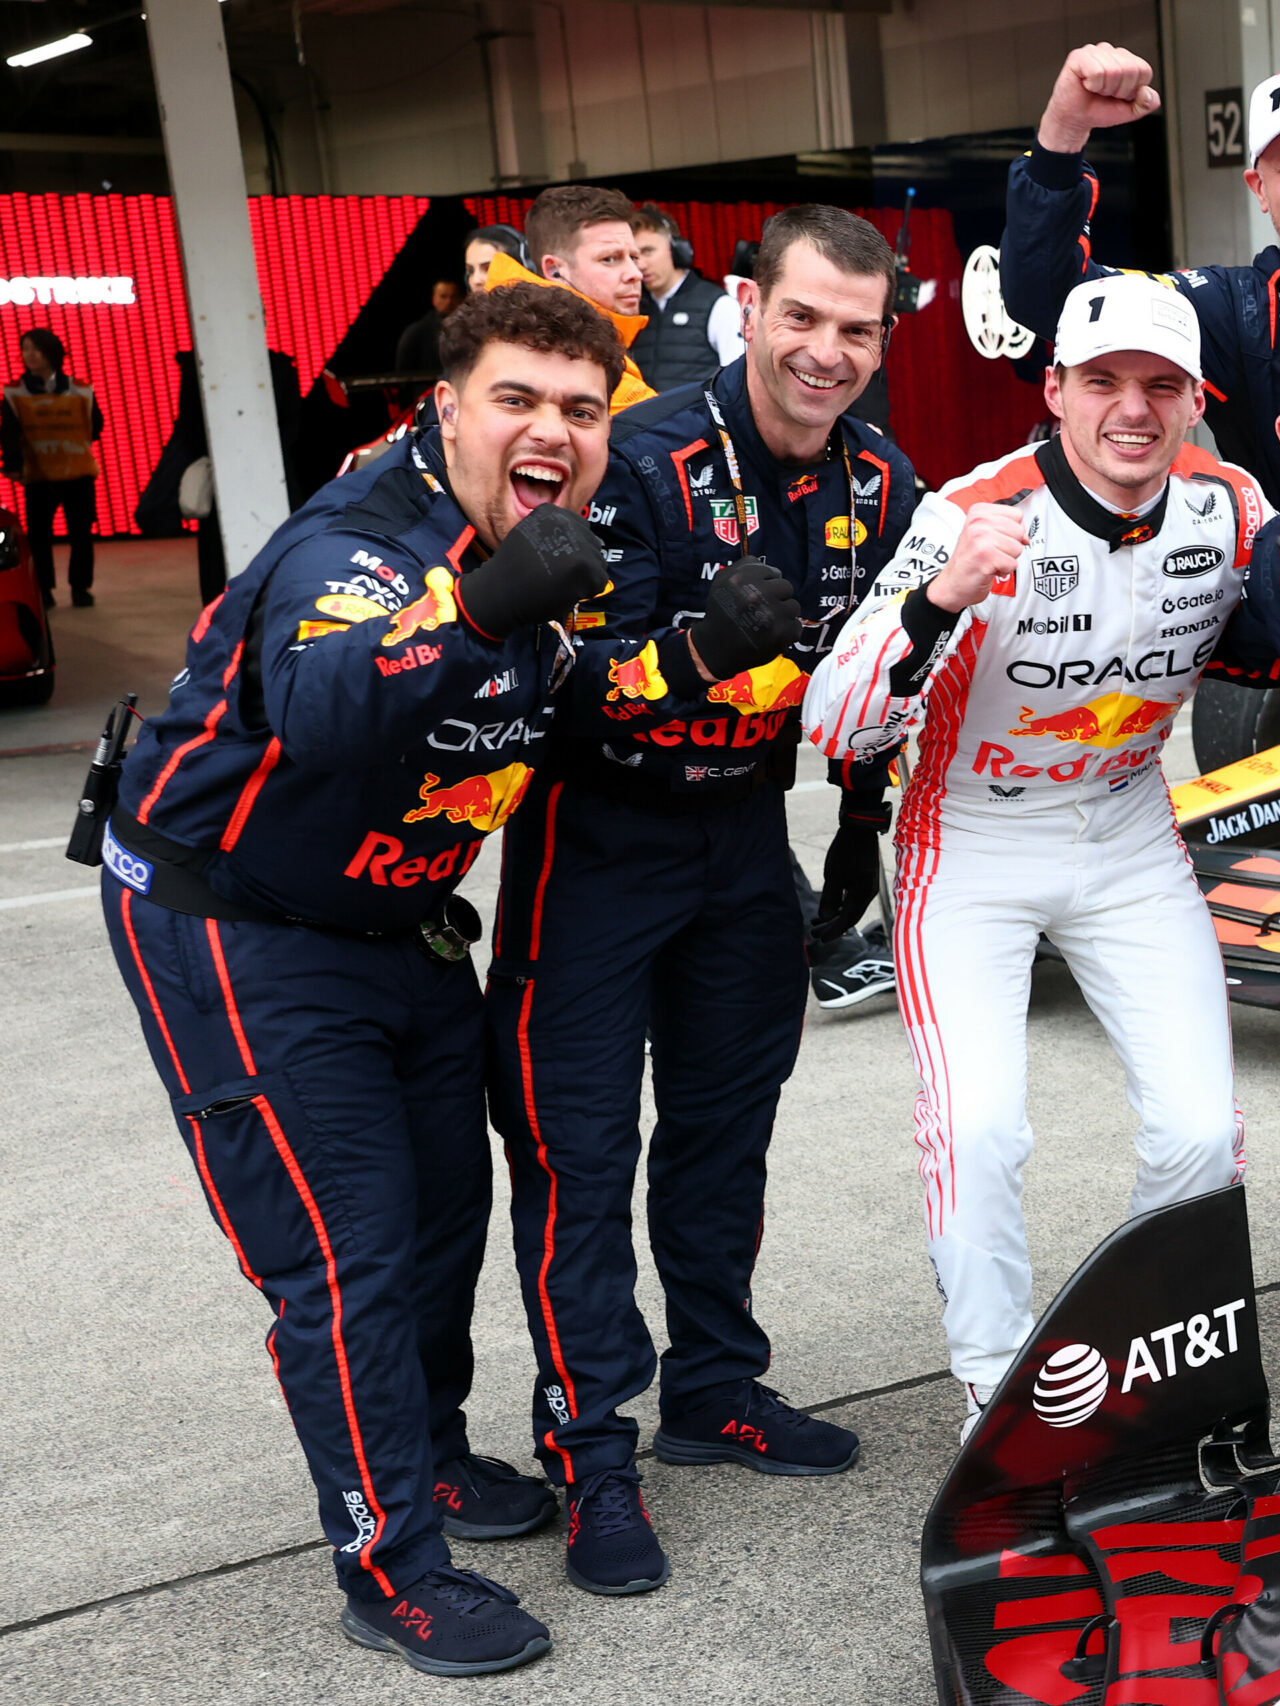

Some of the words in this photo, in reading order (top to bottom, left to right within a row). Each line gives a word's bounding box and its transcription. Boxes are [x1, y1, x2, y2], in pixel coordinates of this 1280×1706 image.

[1207, 101, 1243, 157] 52
[1089, 296, 1105, 323] 1
[714, 518, 757, 542] HEUR
[832, 525, 860, 540] RAUH
[1036, 558, 1075, 575] TAG
[1176, 550, 1217, 571] RAUCH
[1037, 576, 1076, 598] HEUER
[1177, 588, 1225, 611] Gate.io
[1017, 616, 1069, 635] Mobil
[1160, 615, 1221, 639] HONDA
[374, 647, 417, 678] Red
[1006, 639, 1216, 690] ORACLE
[632, 716, 729, 748] ed
[1206, 811, 1252, 845] JACK
[344, 830, 460, 888] Red
[1120, 1298, 1247, 1395] AT&T
[339, 1489, 377, 1554] sparco
